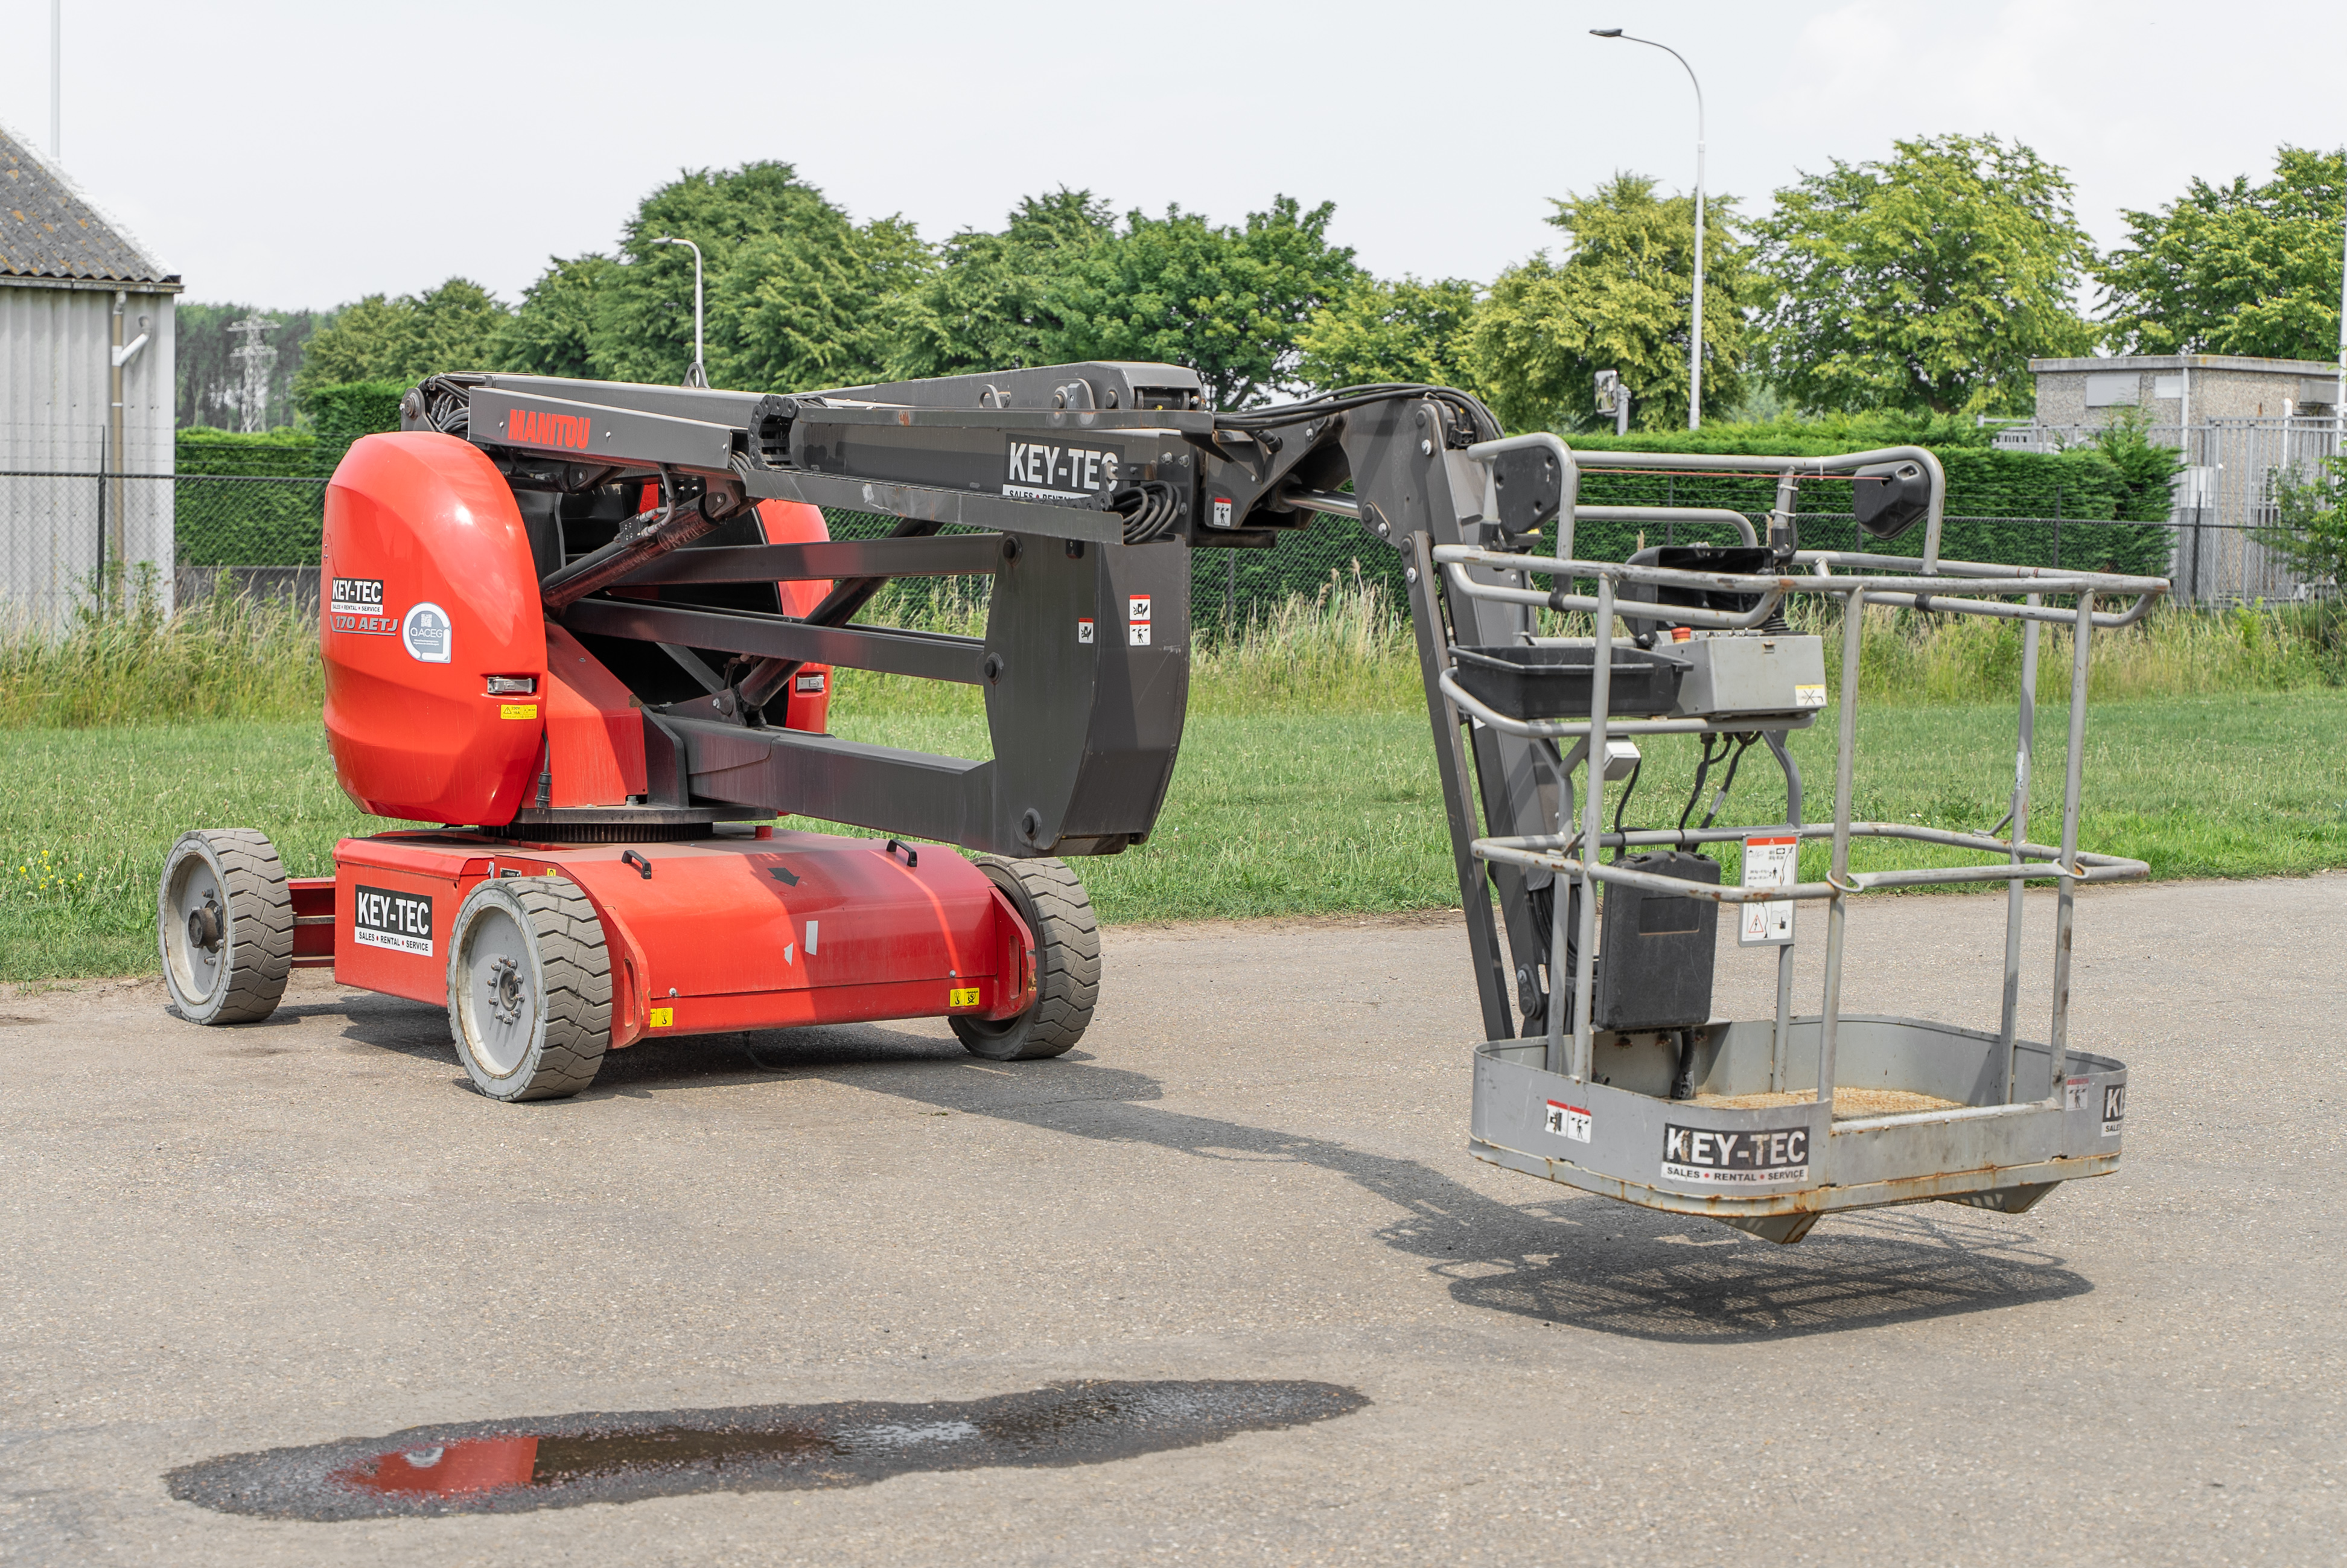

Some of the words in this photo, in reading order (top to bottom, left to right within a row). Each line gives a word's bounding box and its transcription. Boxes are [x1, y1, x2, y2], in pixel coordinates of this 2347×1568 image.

[508, 409, 590, 449] MANITOU
[333, 580, 381, 602] KEY-TEC
[336, 616, 355, 629] 170
[358, 617, 398, 631] AETJ
[358, 892, 429, 935] KEY-TEC
[359, 931, 375, 942] SALES
[380, 935, 400, 946] RENTAL
[406, 940, 428, 951] SERVICE
[1667, 1127, 1806, 1165] KEY-TEC
[1667, 1167, 1700, 1178] SALES
[1714, 1173, 1757, 1181] RENTAL
[1768, 1170, 1804, 1181] SERVICE
